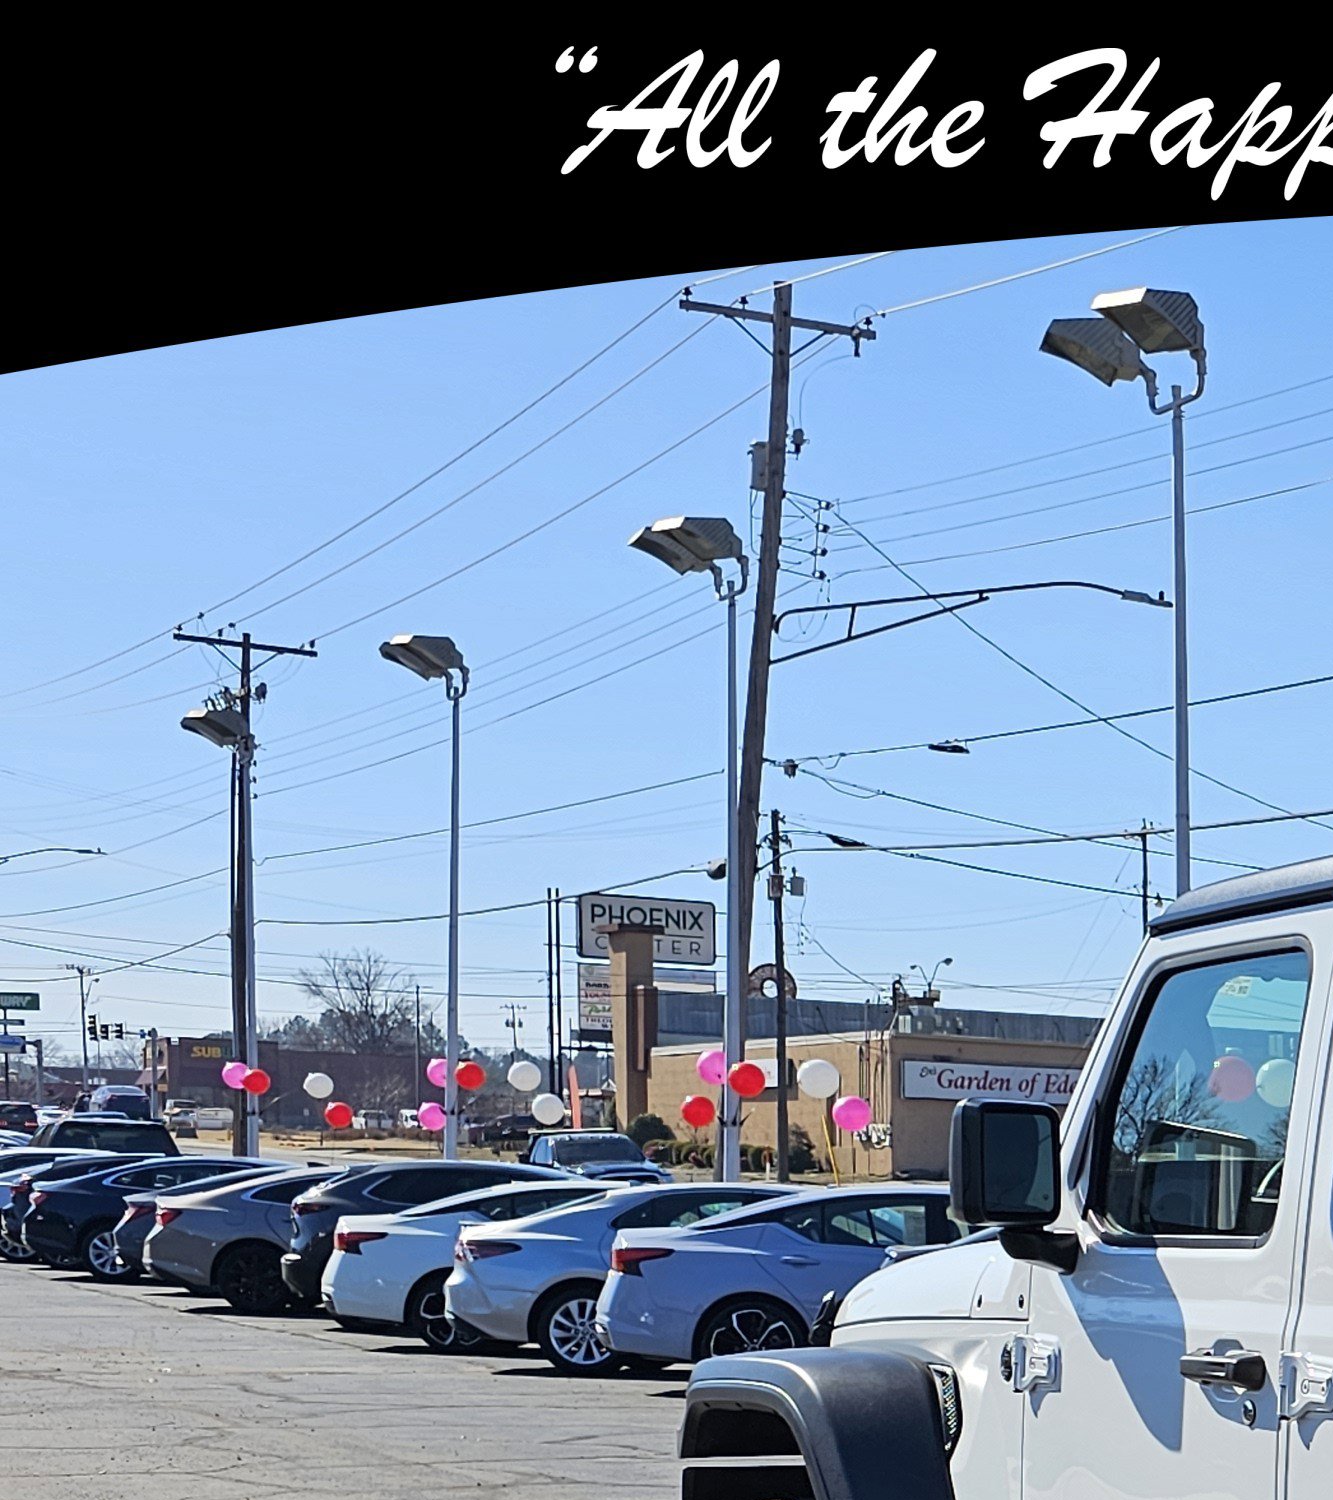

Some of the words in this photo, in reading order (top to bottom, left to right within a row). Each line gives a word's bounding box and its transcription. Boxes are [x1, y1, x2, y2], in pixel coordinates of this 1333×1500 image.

[590, 903, 704, 932] PHOENIX
[595, 935, 701, 956] CTER
[936, 1068, 1012, 1092] Garden
[1018, 1072, 1041, 1098] of
